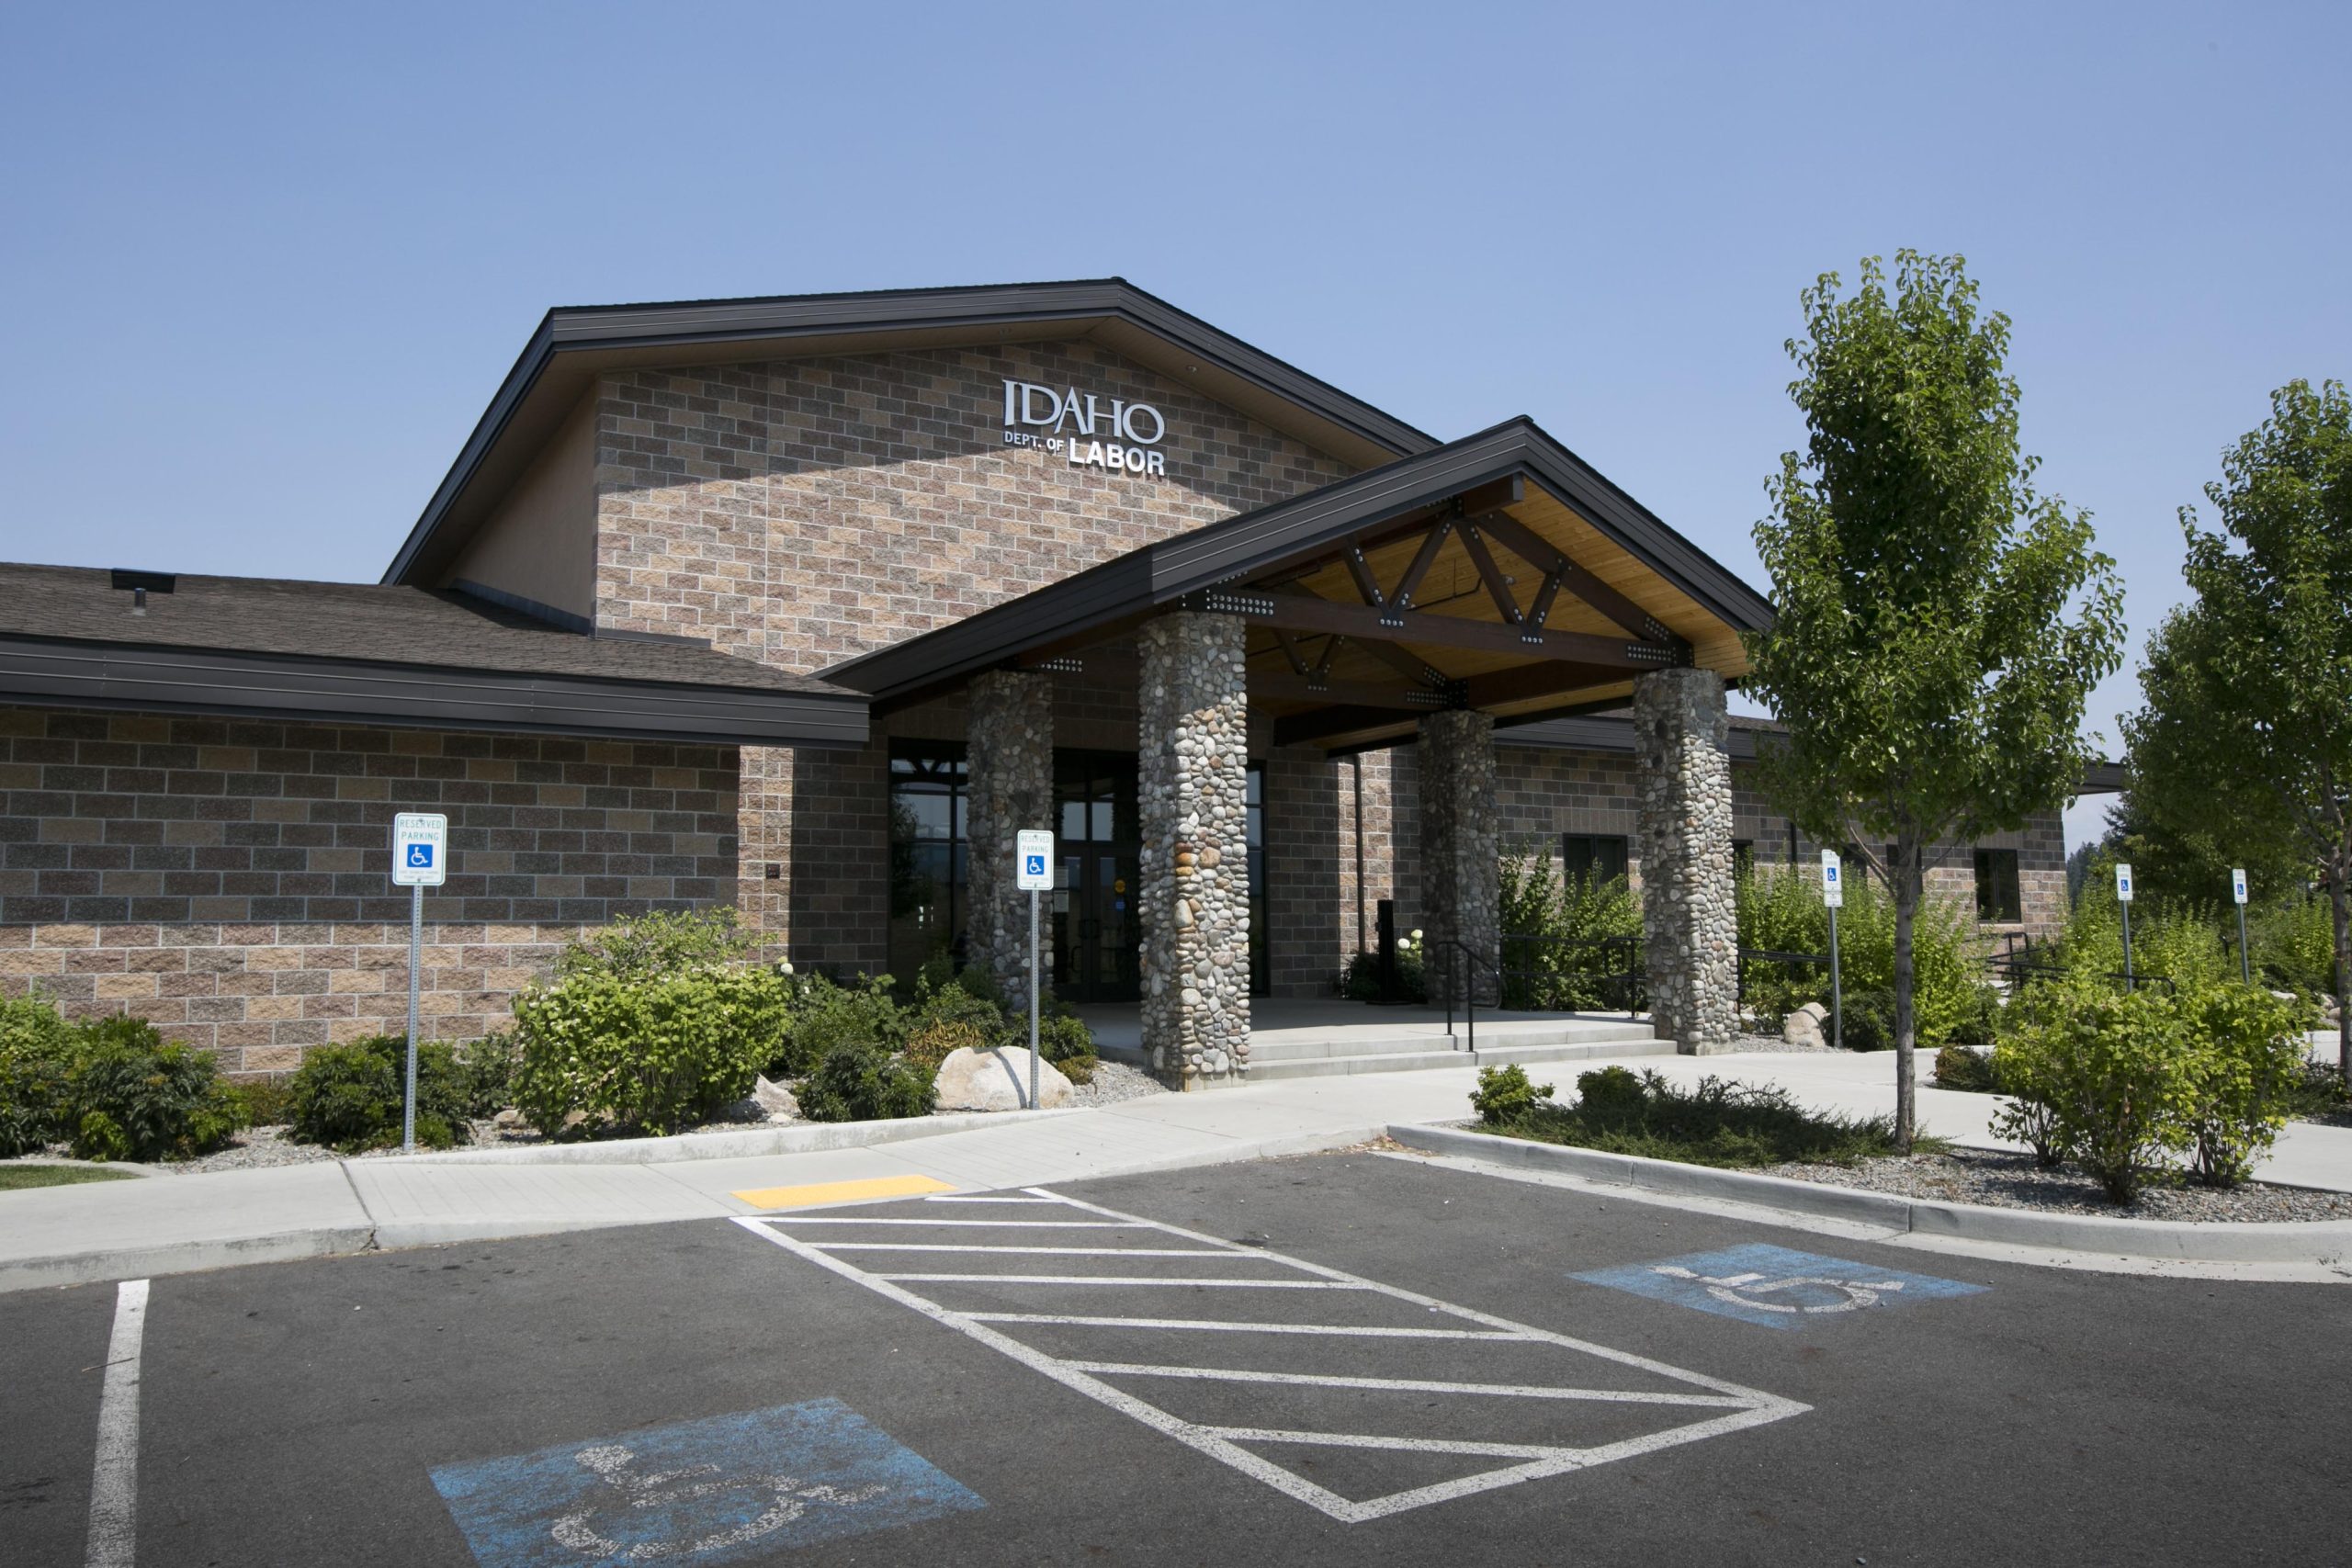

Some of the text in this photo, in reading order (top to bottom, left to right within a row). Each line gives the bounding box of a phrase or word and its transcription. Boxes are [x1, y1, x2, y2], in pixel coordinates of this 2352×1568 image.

[1002, 379, 1165, 445] IDAHO
[1004, 431, 1165, 476] DEPT. OF LABOR
[400, 819, 441, 829] RESERVED
[401, 831, 439, 840] PARKING
[1021, 835, 1050, 843] RESERVED
